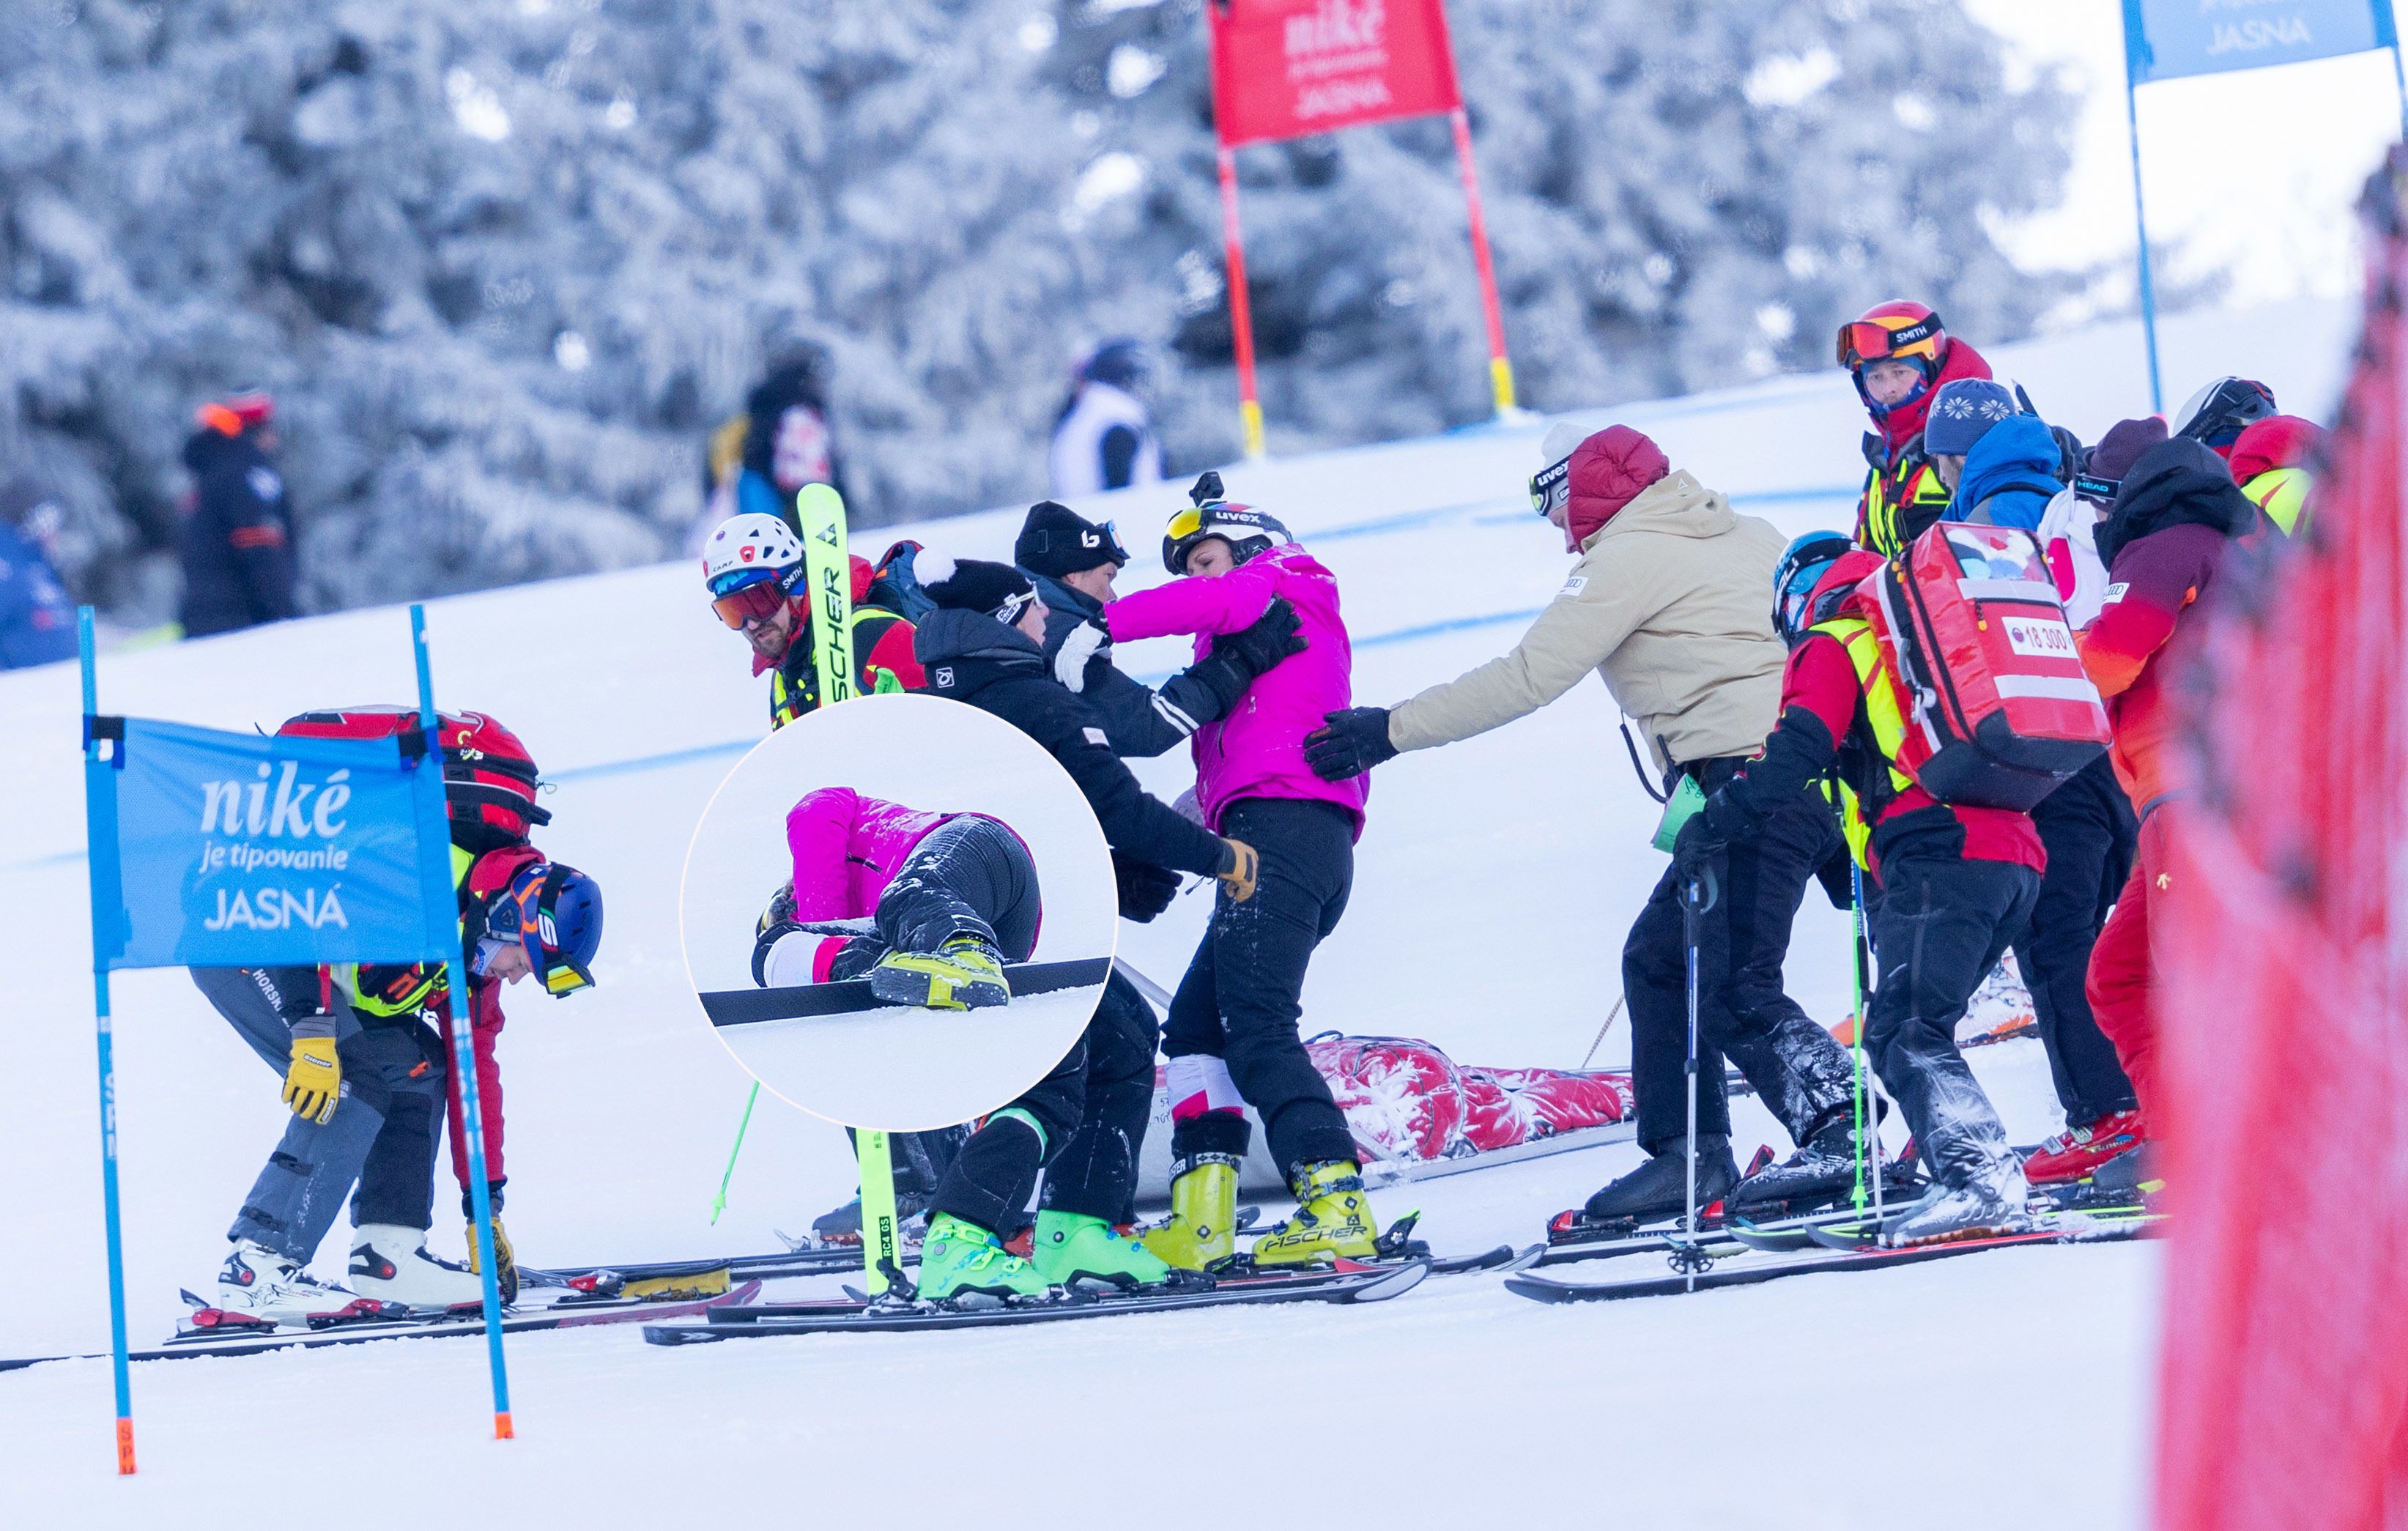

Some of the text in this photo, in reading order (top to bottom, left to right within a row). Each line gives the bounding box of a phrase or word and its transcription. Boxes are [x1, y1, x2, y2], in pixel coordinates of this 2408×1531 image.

[1895, 325, 1928, 344] SMITH
[1537, 460, 1569, 486] uvex
[2077, 481, 2108, 492] HEAD
[1215, 511, 1262, 524] uvex
[713, 560, 733, 572] CAMP
[782, 566, 803, 589] SMITH
[824, 567, 848, 703] SCHER
[2025, 626, 2067, 650] 18 300
[199, 761, 351, 837] niké
[199, 840, 348, 873] je tipovanie
[204, 882, 349, 930] JASNÁ
[253, 968, 284, 1012] HORSK
[880, 1217, 892, 1257] RC4 GS
[1264, 1226, 1368, 1252] FISCHER
